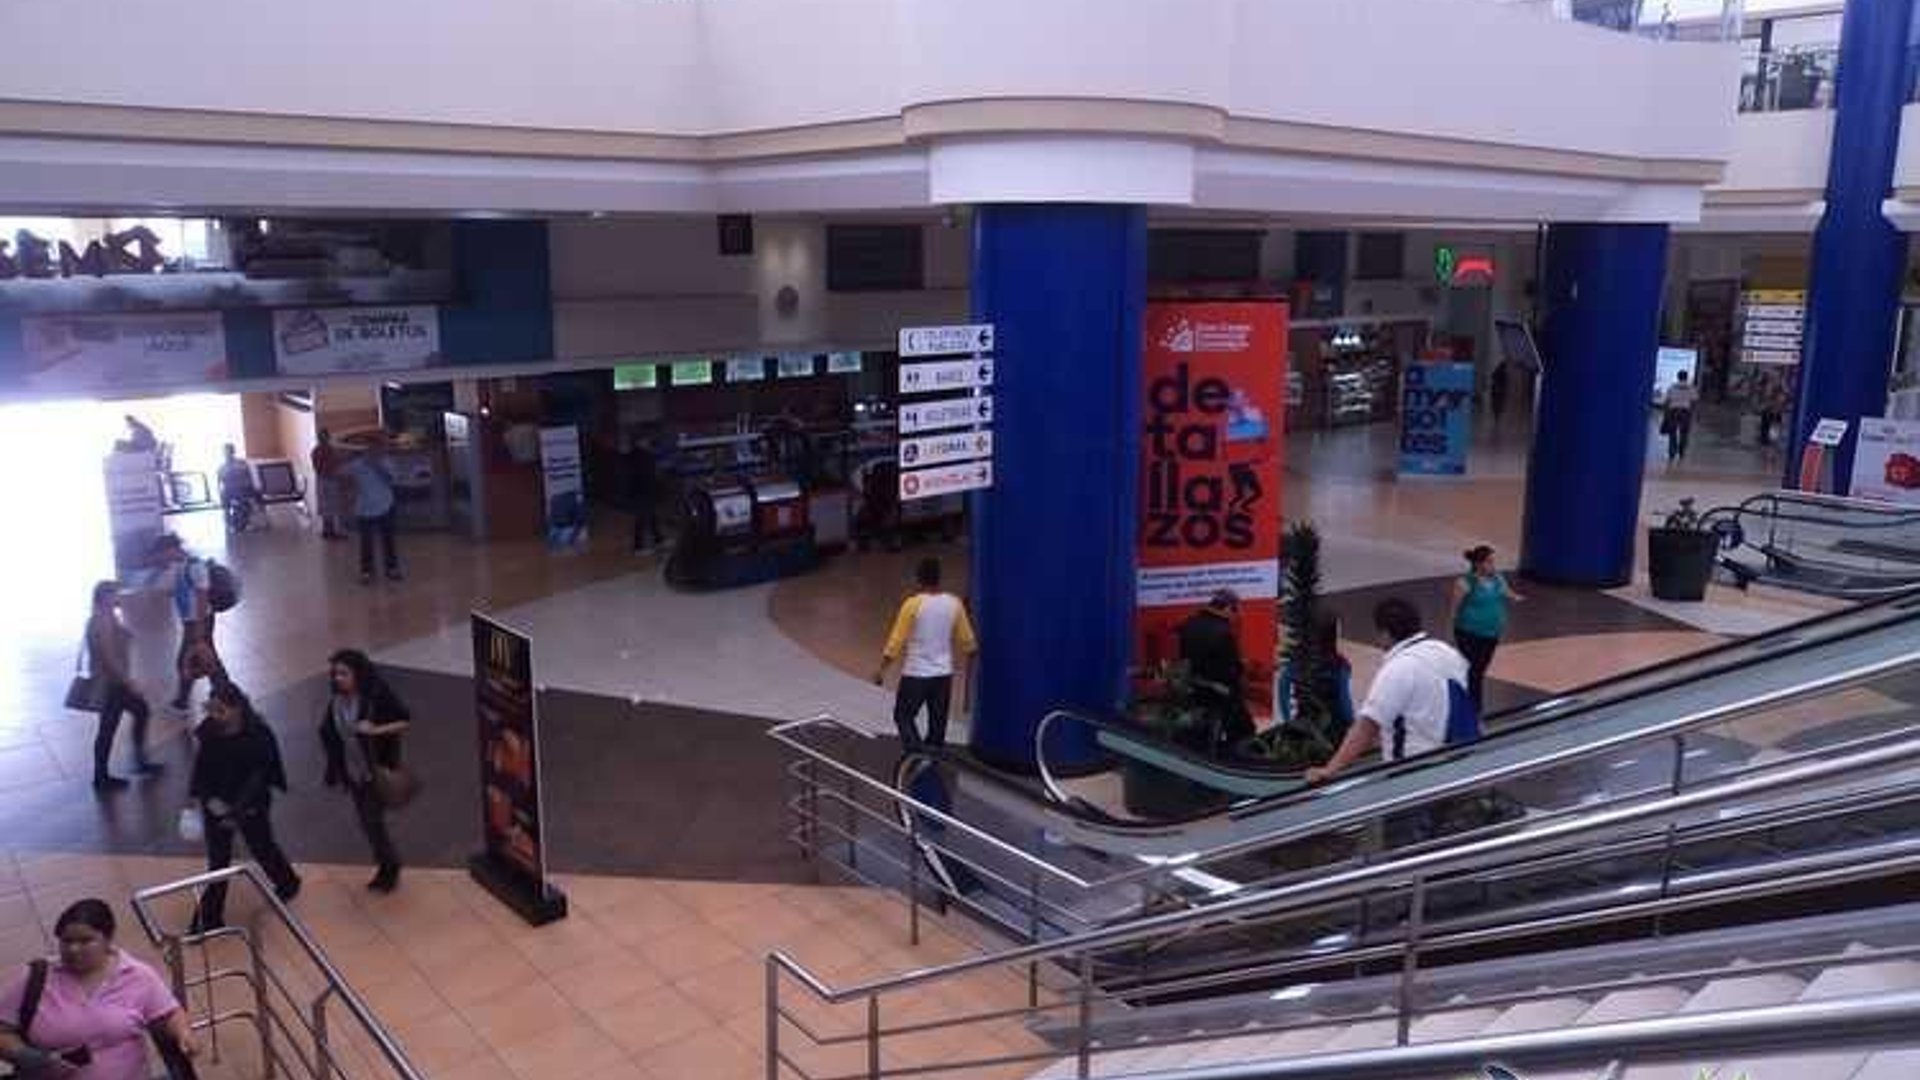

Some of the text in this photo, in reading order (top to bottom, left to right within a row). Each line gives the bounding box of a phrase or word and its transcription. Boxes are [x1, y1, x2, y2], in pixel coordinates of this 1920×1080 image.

[1150, 363, 1230, 413] de
[1147, 415, 1217, 460] ta
[1147, 514, 1254, 548] zos
